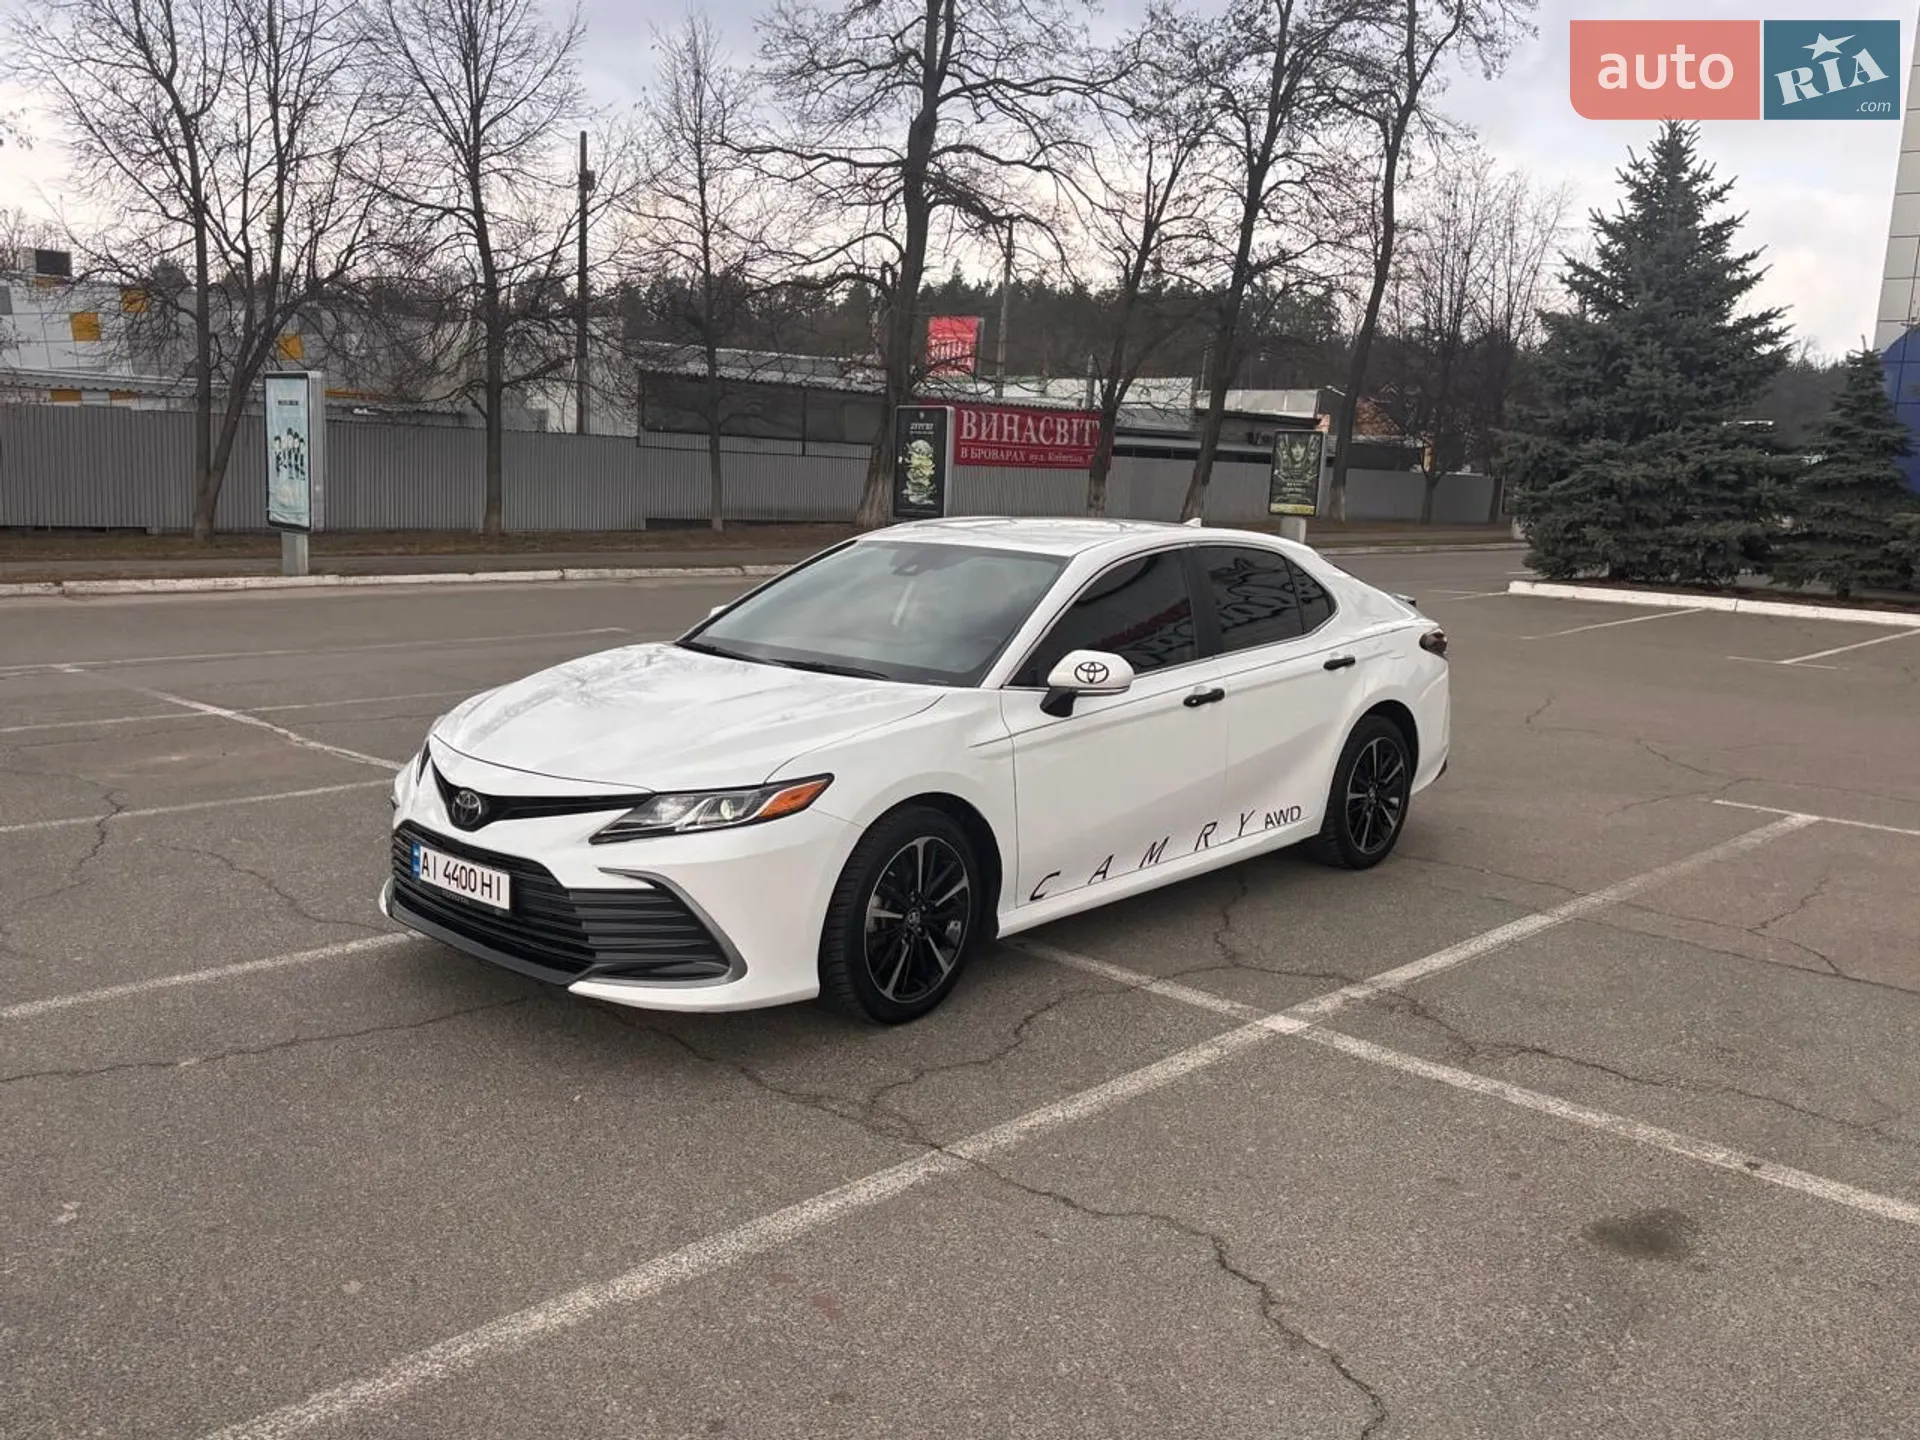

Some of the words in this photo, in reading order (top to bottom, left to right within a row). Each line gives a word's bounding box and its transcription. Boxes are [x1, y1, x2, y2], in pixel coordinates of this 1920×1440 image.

[960, 409, 1101, 447] ВИНАСВІТ
[960, 447, 968, 459] В
[970, 448, 1027, 462] БРОВАРАХ
[1029, 809, 1256, 901] CAMRY
[1264, 804, 1302, 830] AWD
[421, 851, 437, 881] AI
[443, 860, 477, 893] 4400
[481, 871, 501, 902] HI
